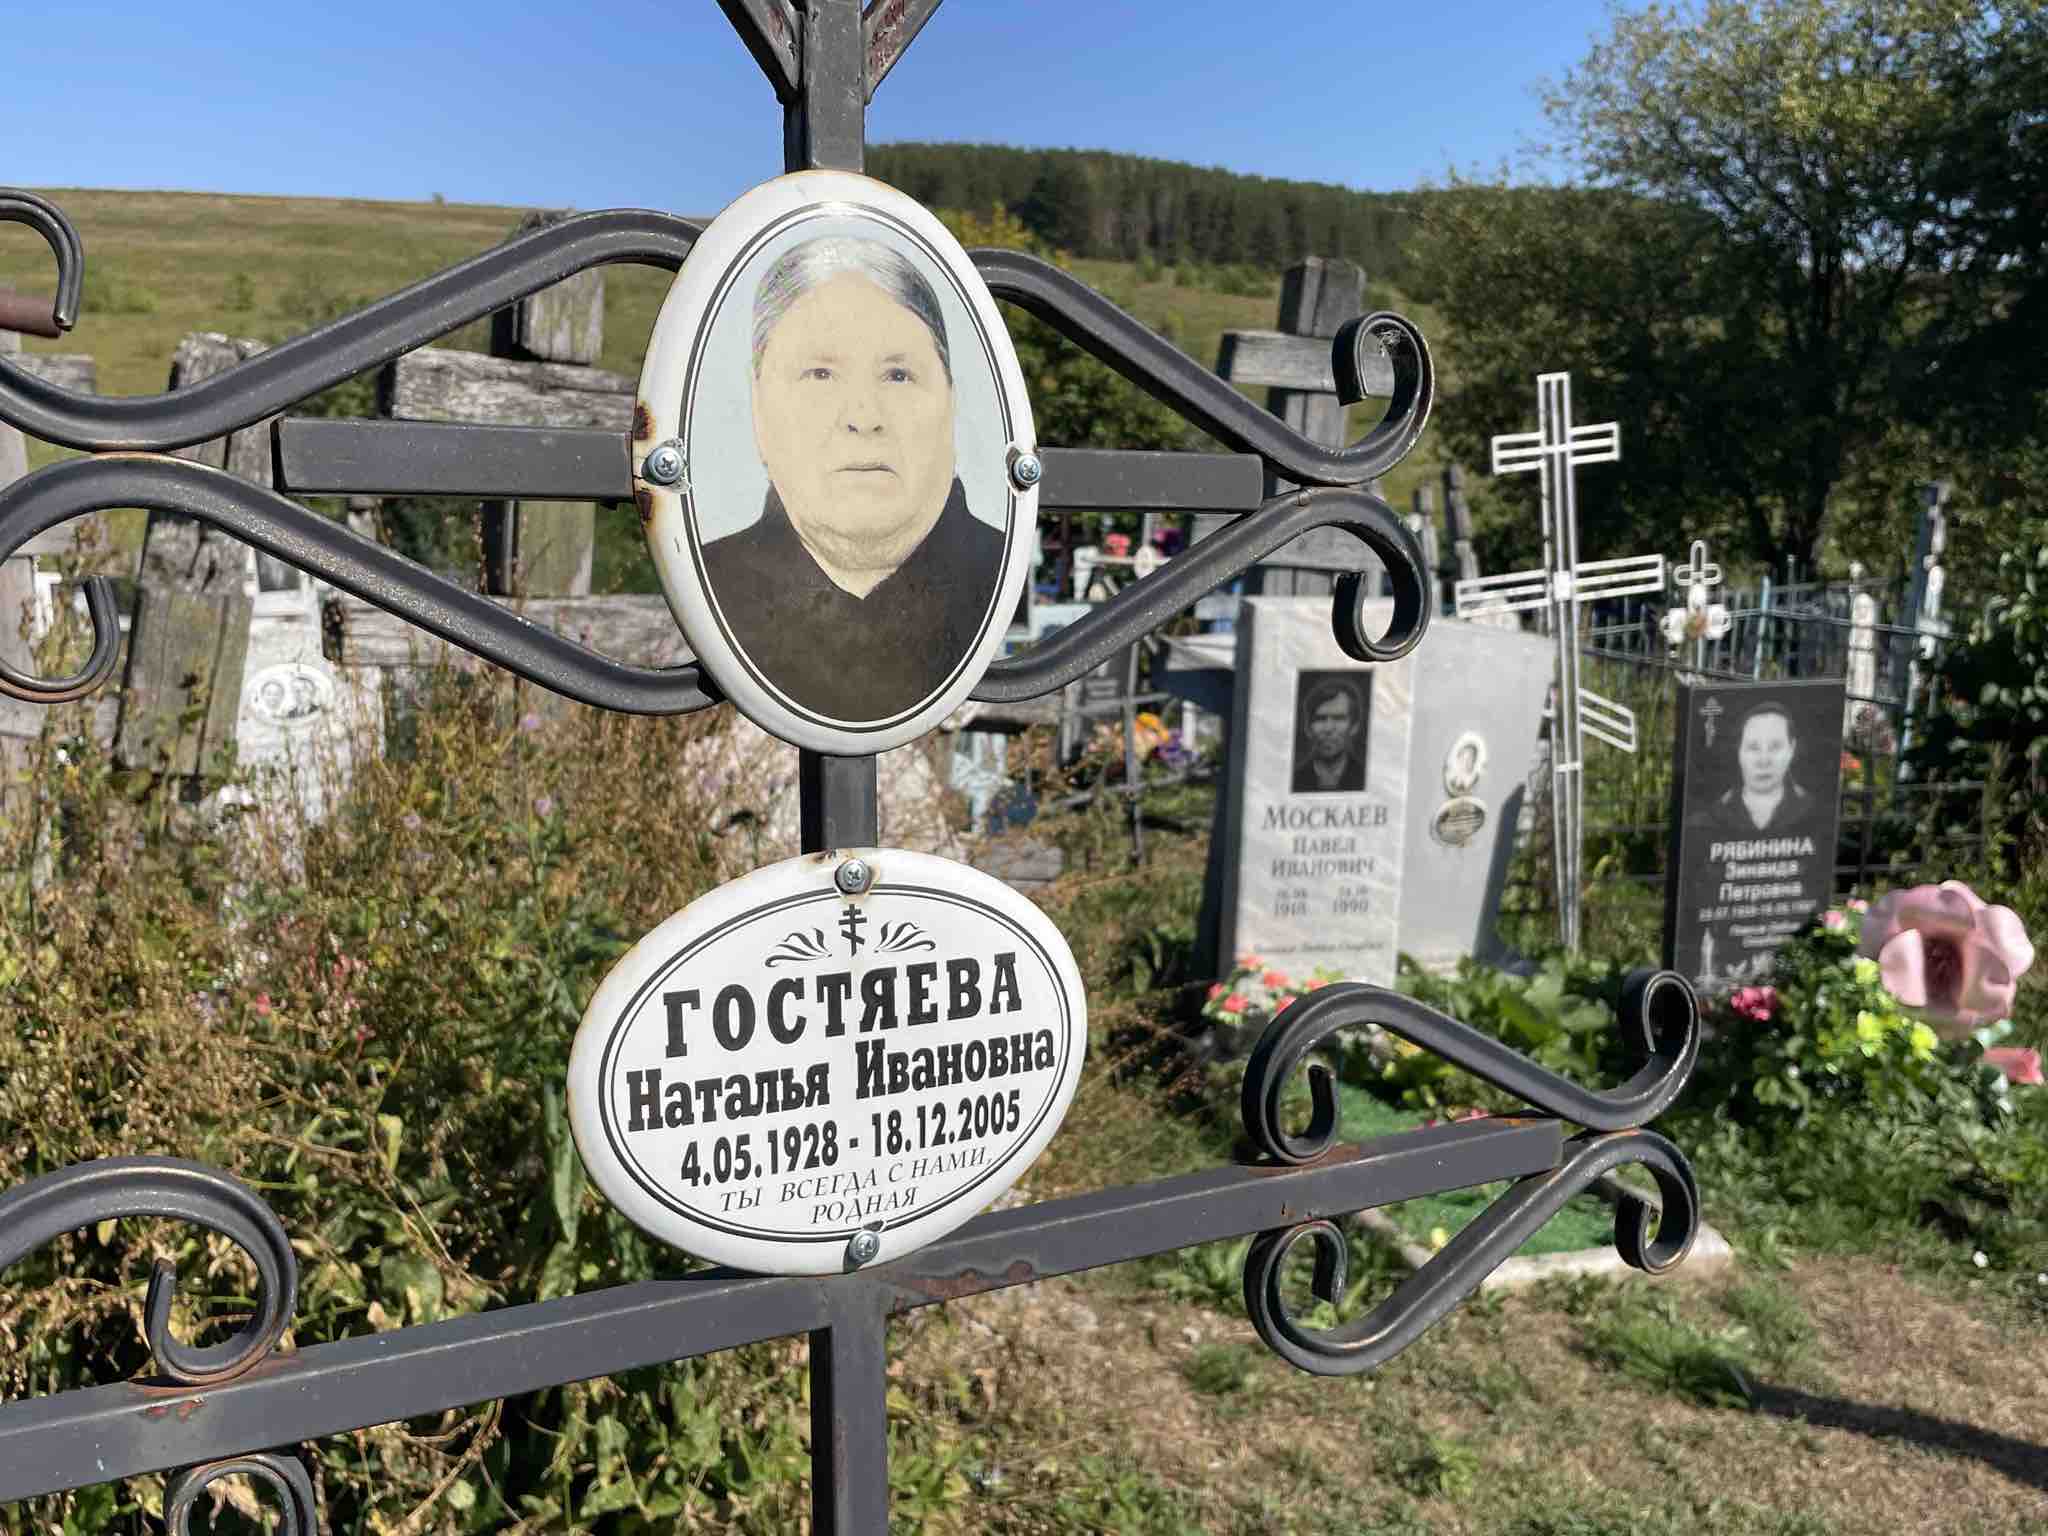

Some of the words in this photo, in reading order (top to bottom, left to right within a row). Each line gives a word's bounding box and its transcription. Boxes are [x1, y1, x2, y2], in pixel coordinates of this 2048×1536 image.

[1260, 804, 1388, 830] МОСКАЕВ
[1293, 836, 1356, 855] ПАВЕЛ
[1710, 837, 1816, 862] РЯБИНИНА
[1271, 856, 1377, 878] ИВАНОВИЧ
[1719, 882, 1803, 902] Петровна
[663, 952, 1022, 1058] ГОСТЯЕВА
[627, 1062, 830, 1132] Наталья
[854, 1028, 1055, 1100] Ивановна
[681, 1119, 839, 1187] 4.05.1928
[849, 1136, 859, 1150] -
[871, 1089, 1021, 1159] 18.12.2005
[719, 1187, 761, 1212] ТЫ
[779, 1168, 878, 1203] ВСЕГДА
[888, 1163, 903, 1183] С
[911, 1146, 992, 1179] НАМИ,
[811, 1186, 919, 1225] РОДНАЯ
